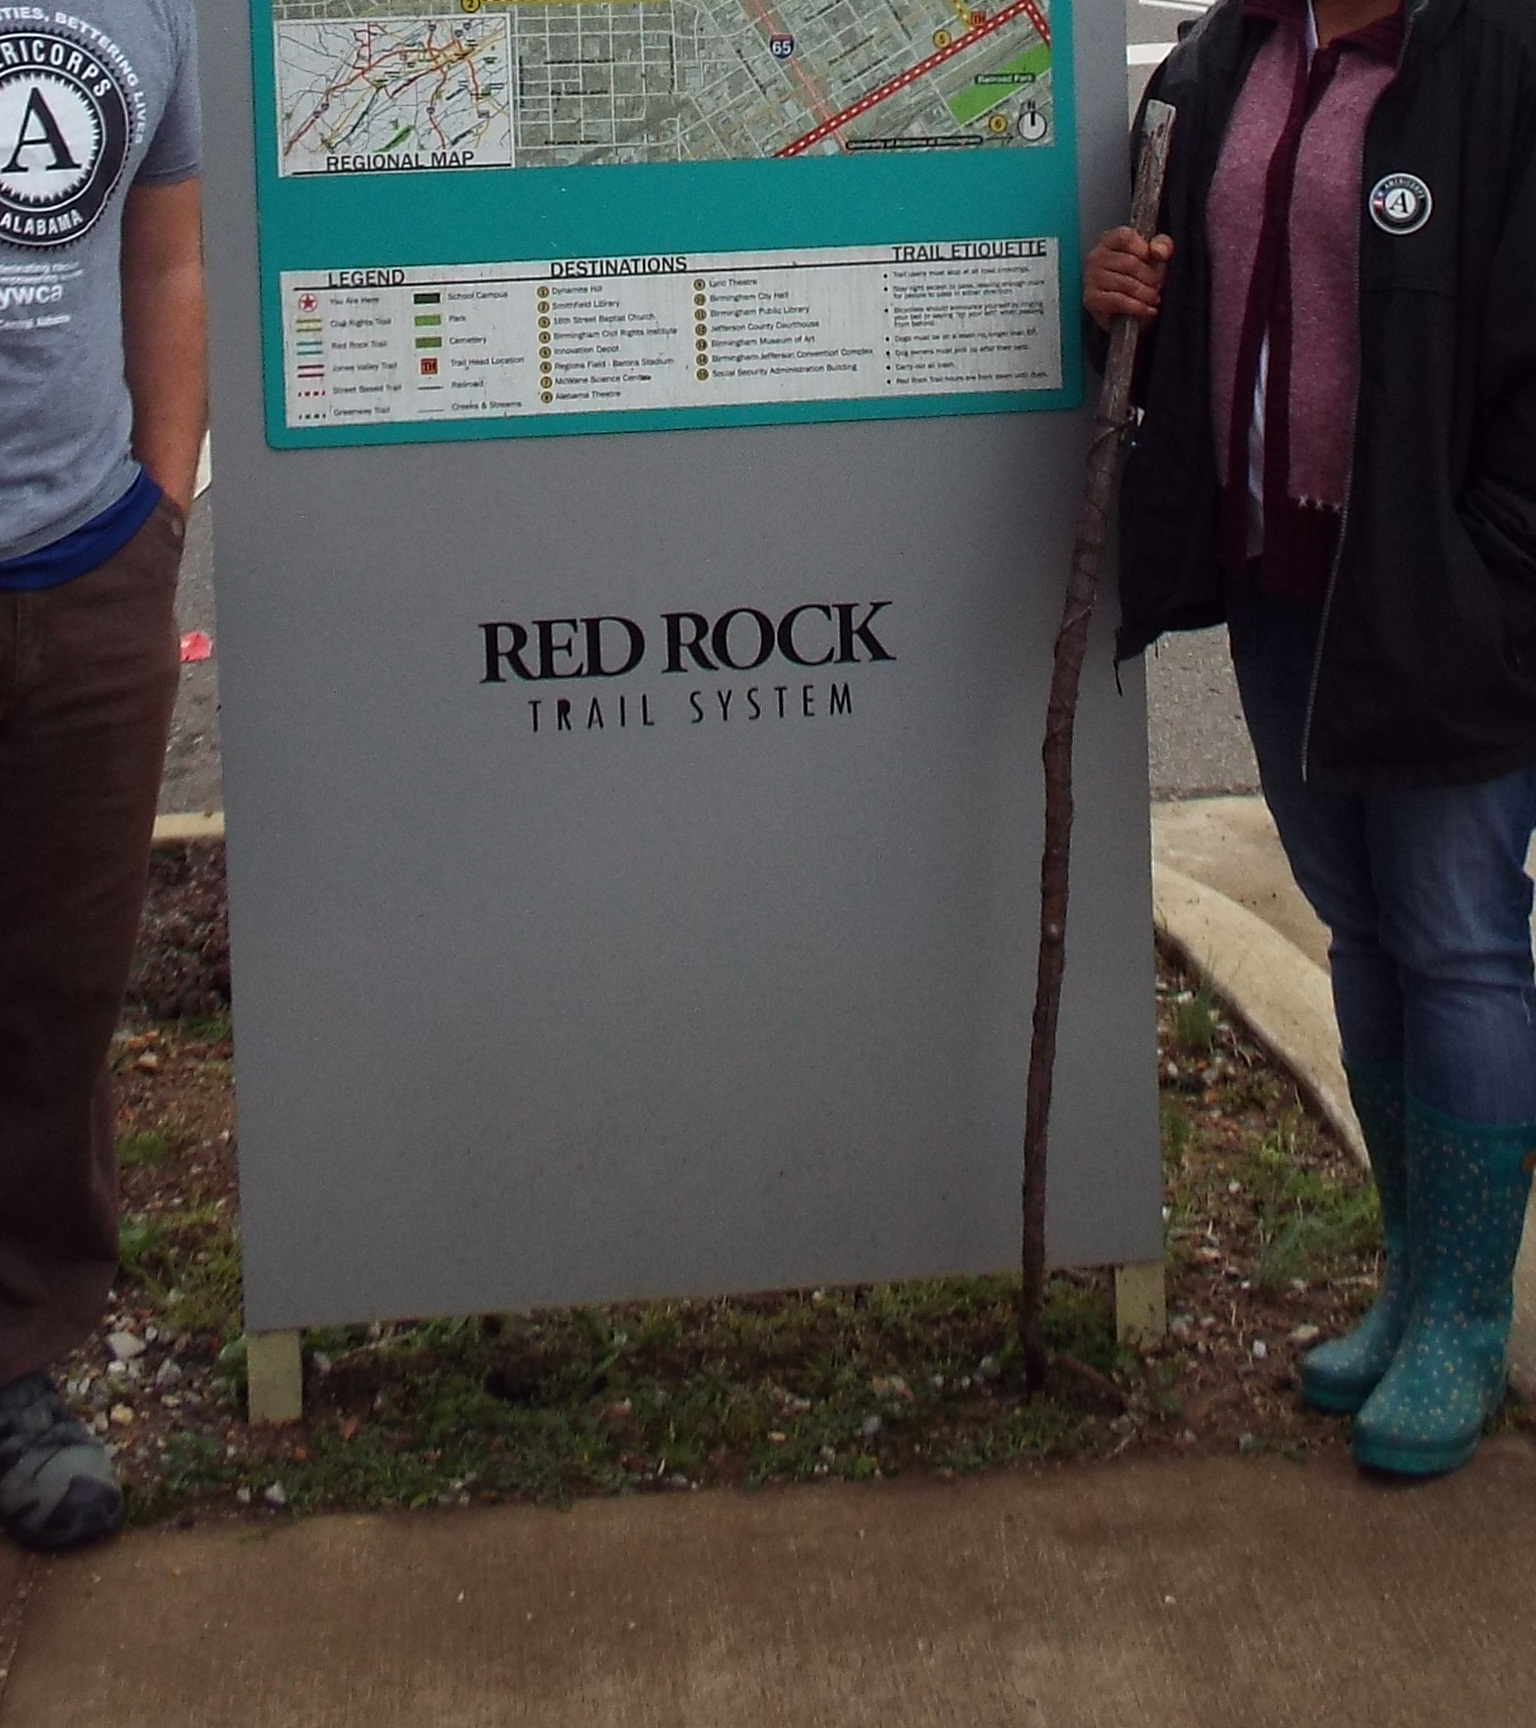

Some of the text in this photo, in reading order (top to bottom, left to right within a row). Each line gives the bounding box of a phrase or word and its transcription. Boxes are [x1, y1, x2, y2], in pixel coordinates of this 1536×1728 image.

[772, 41, 791, 54] 65
[54, 11, 139, 87] BETTERING
[133, 91, 147, 144] LIVES
[0, 86, 82, 173] A
[326, 151, 474, 171] REGIONAL MAP
[1389, 192, 1408, 213] A
[0, 209, 83, 235] ALABAMA
[892, 240, 1046, 261] TRAIL ETIQUETTE
[329, 269, 405, 287] LEGEND
[551, 256, 687, 278] DESTINATIONS
[478, 602, 896, 684] RED ROCK
[528, 683, 853, 732] TRAIL SYSTEM
